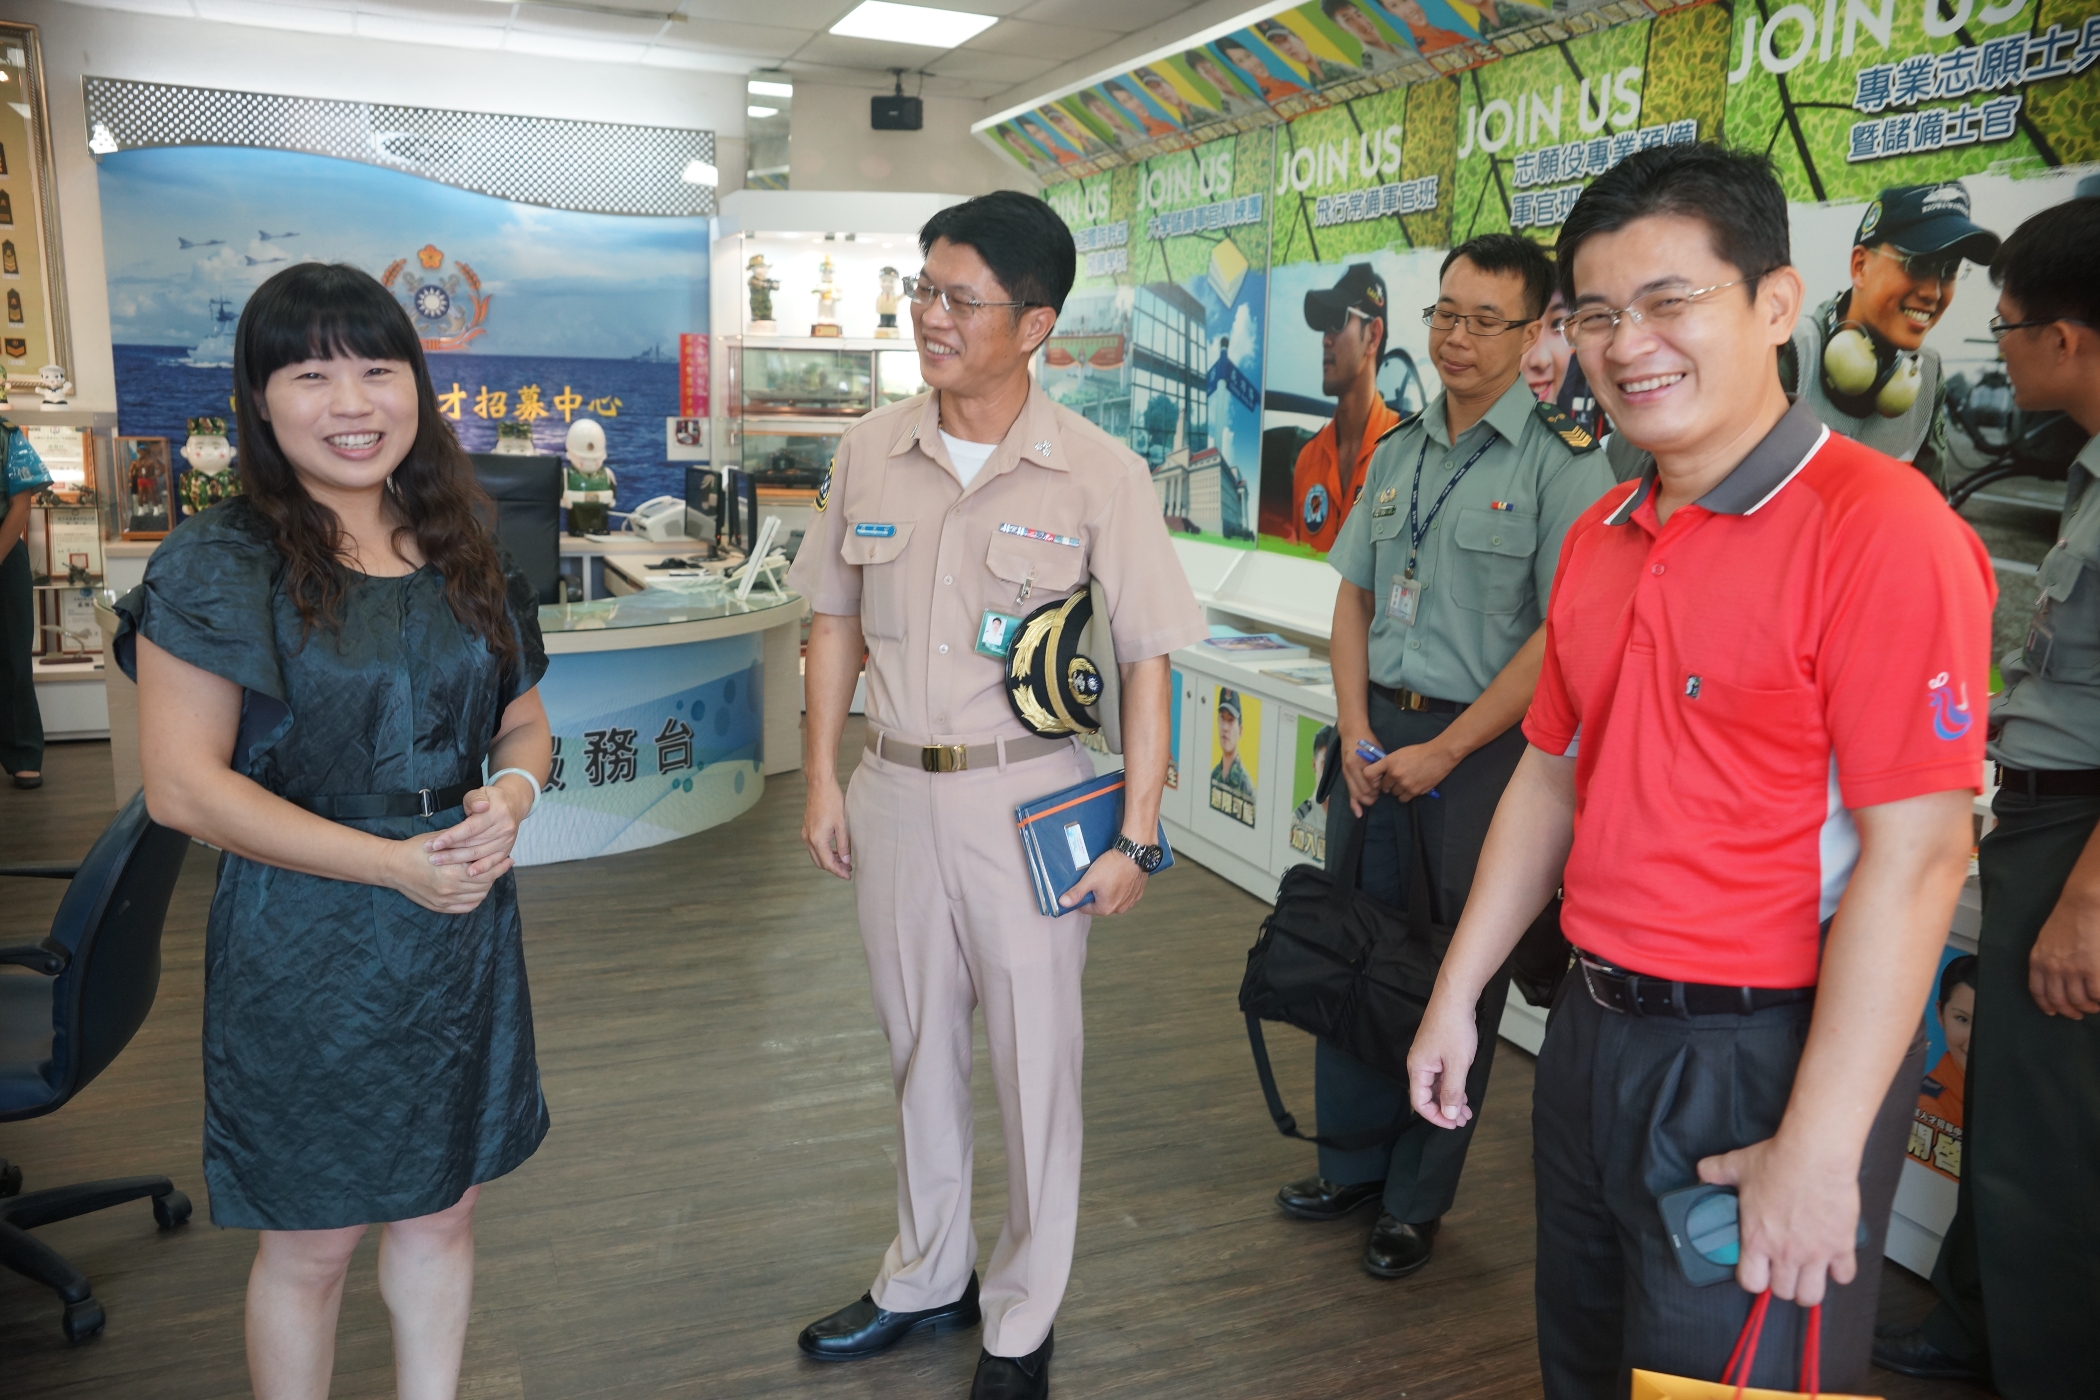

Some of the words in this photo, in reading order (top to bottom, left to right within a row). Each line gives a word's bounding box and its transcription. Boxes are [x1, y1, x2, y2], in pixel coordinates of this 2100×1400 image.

[1728, 0, 1896, 84] JOIN
[1457, 84, 1563, 160] JOIN
[1578, 66, 1642, 133] US
[1847, 95, 2022, 163] 暨儲備士官
[1137, 162, 1192, 211] JOIN
[1199, 152, 1231, 197] US
[1277, 137, 1349, 195] JOIN
[1359, 125, 1403, 178] US
[1046, 188, 1080, 227] OIN
[1084, 183, 1109, 221] US
[1315, 175, 1438, 228] 飛行常備軍官班
[438, 382, 623, 423] 才招募中心
